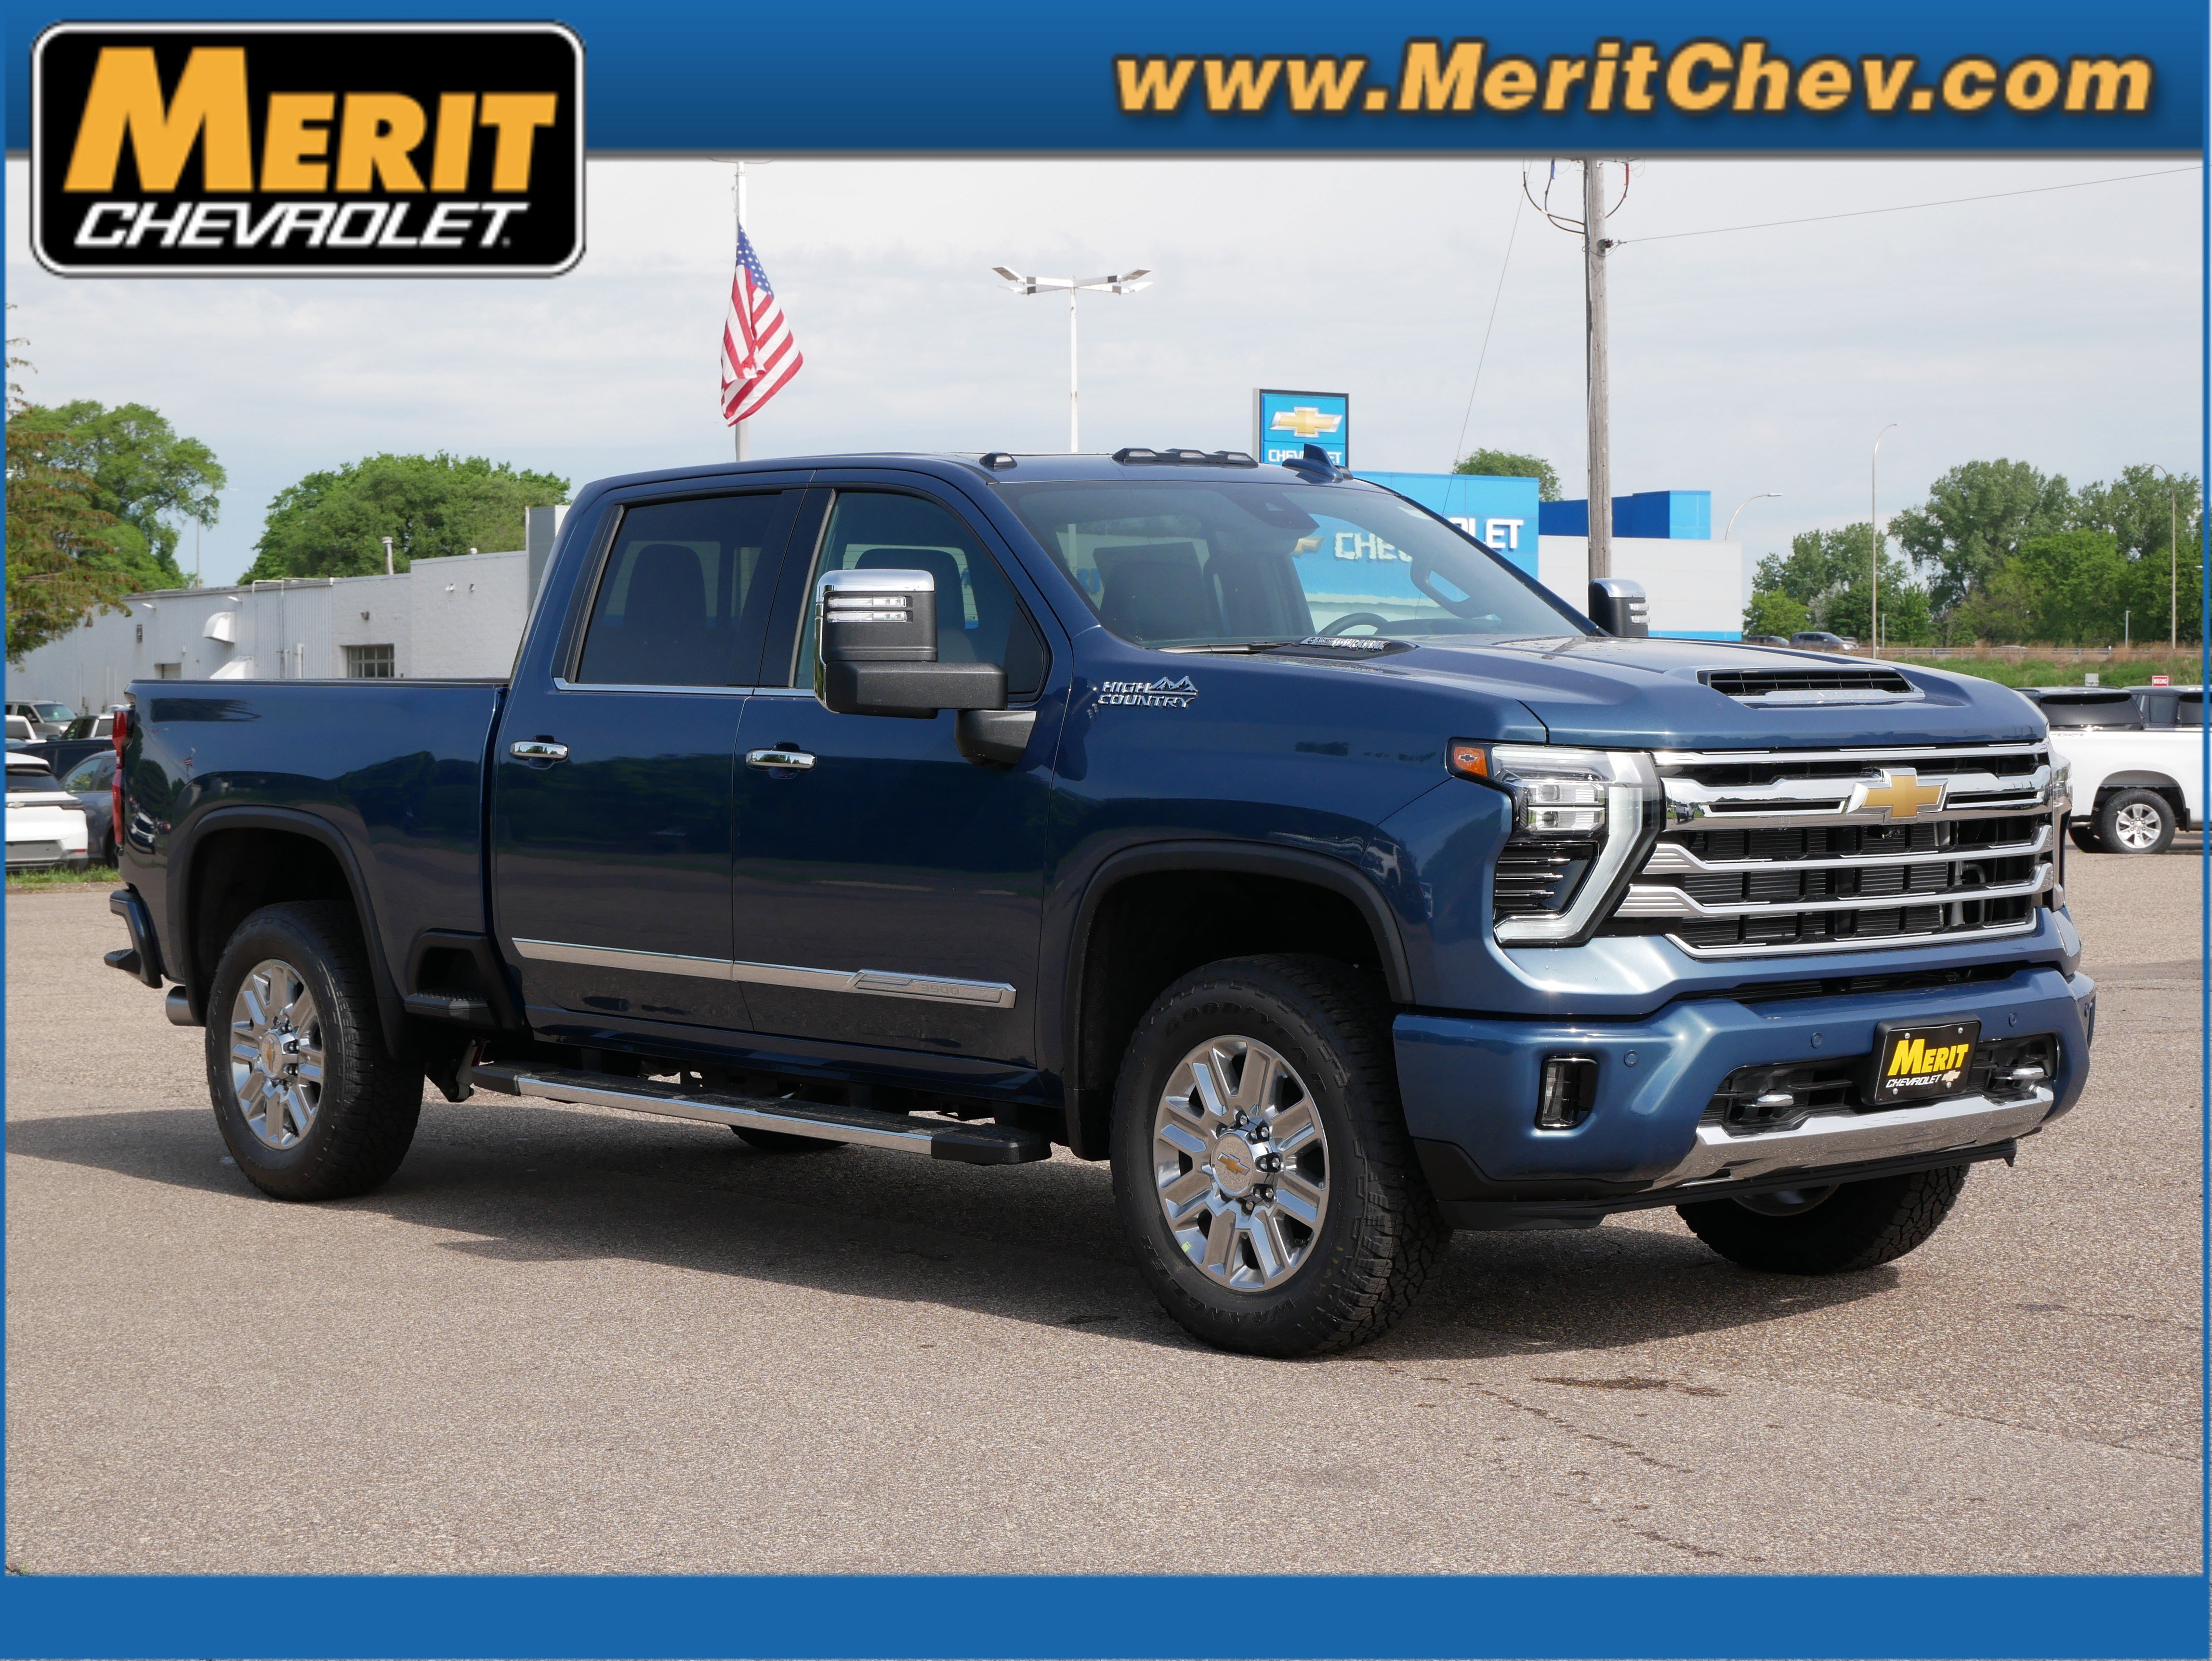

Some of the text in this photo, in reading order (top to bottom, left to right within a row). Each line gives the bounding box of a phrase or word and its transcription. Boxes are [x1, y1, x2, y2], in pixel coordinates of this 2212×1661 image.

[1102, 681, 1153, 693] HIGH
[1098, 694, 1195, 708] COUNTRY
[1887, 1039, 1969, 1076] MERIT
[1885, 1074, 1943, 1088] CHEVROLET
